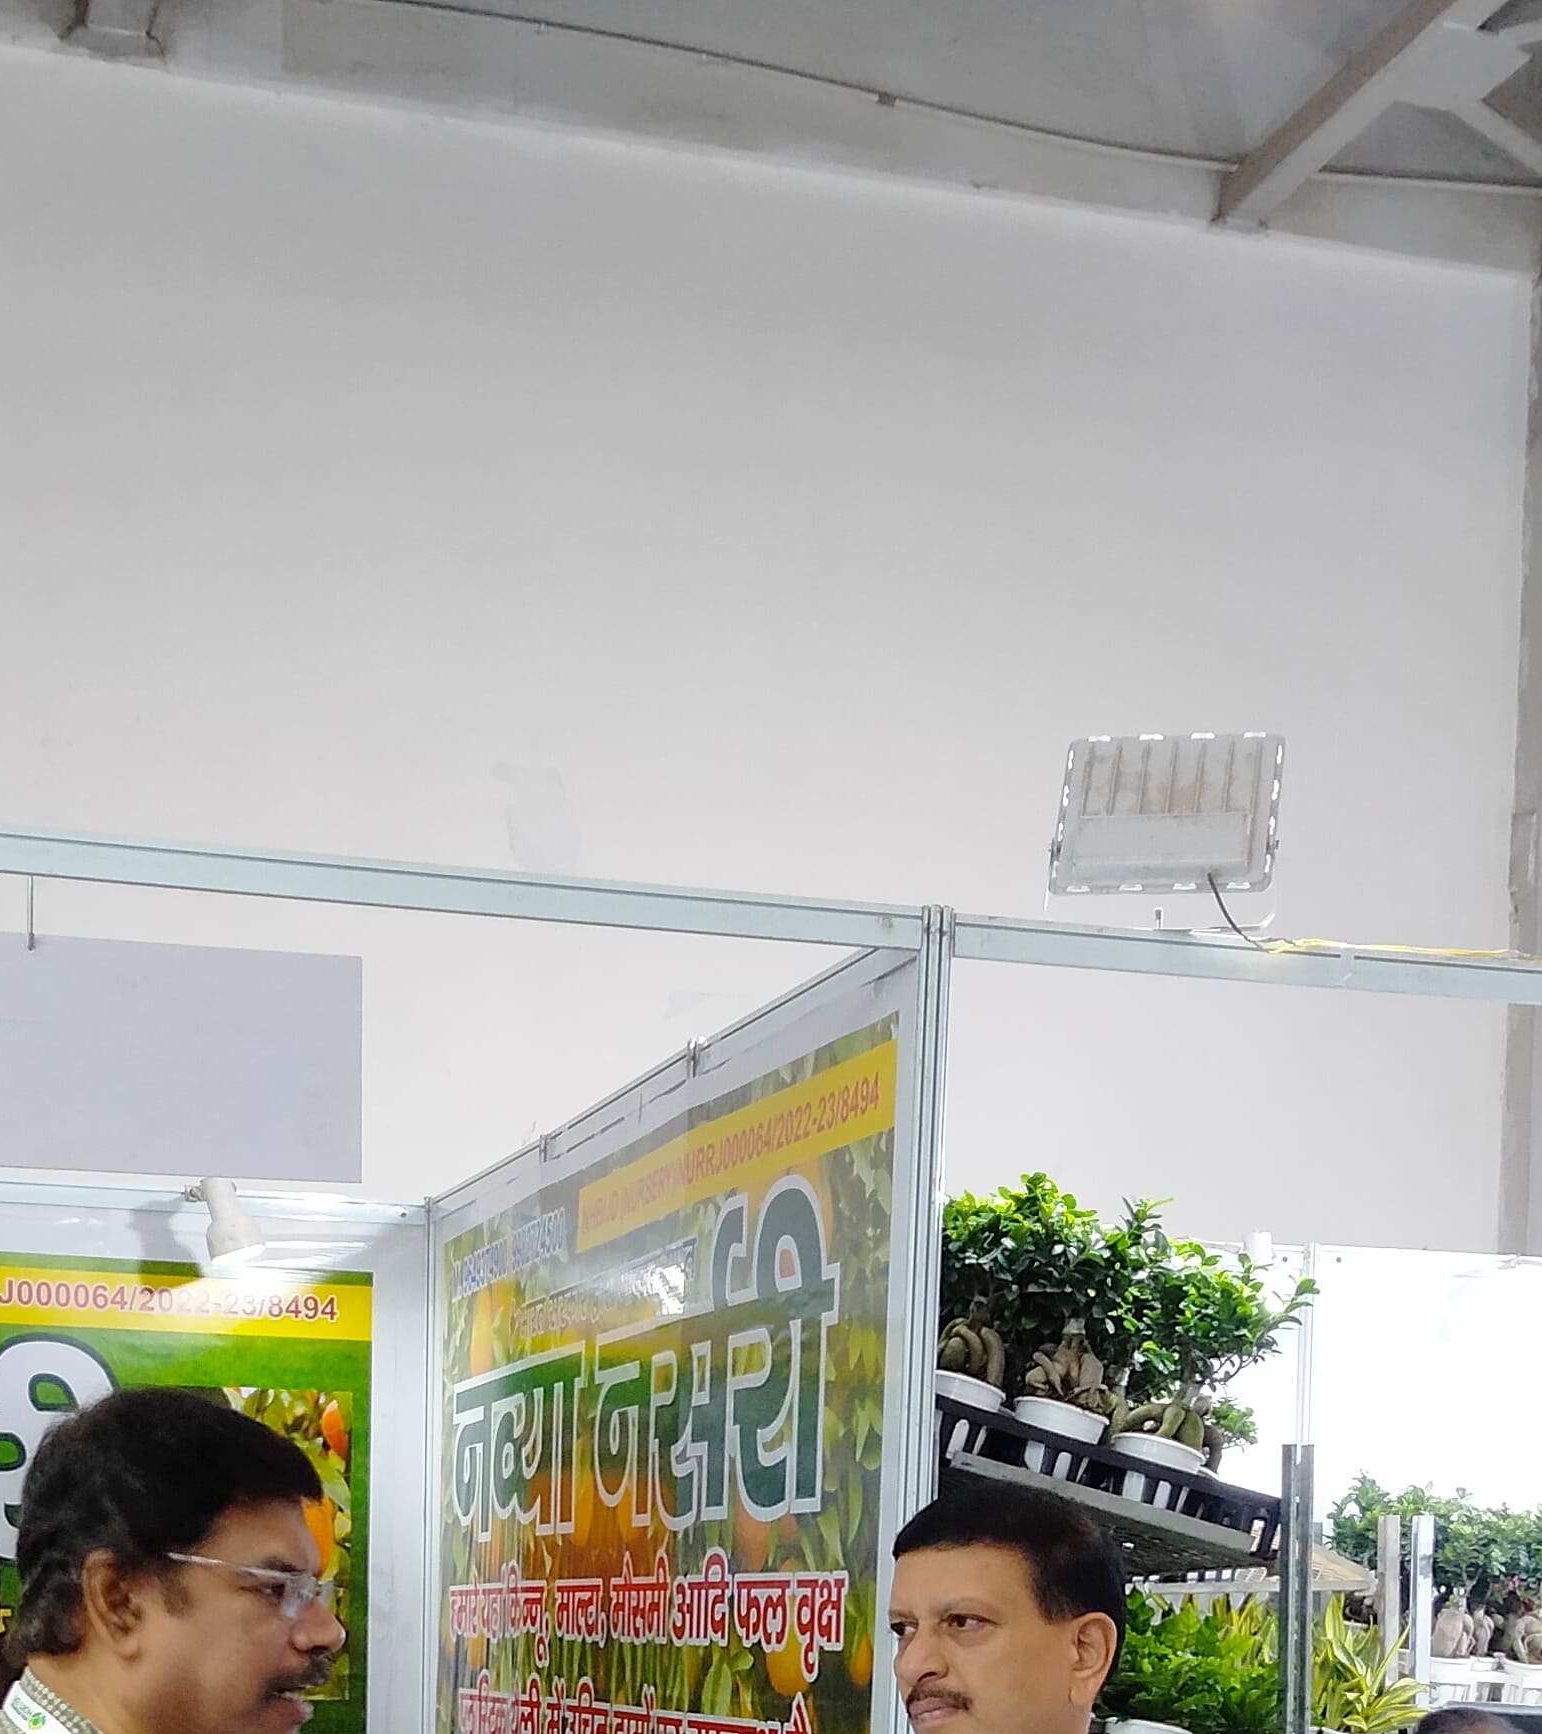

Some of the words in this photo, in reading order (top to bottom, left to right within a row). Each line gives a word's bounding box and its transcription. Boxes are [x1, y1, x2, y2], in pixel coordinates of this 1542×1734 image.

[453, 1341, 586, 1542] नव्या
[595, 1175, 840, 1532] नर्सरी
[610, 1551, 671, 1645] मौसमी
[672, 1546, 732, 1647] आदि
[734, 1571, 792, 1652] फल
[794, 1570, 849, 1683] वृक्ष
